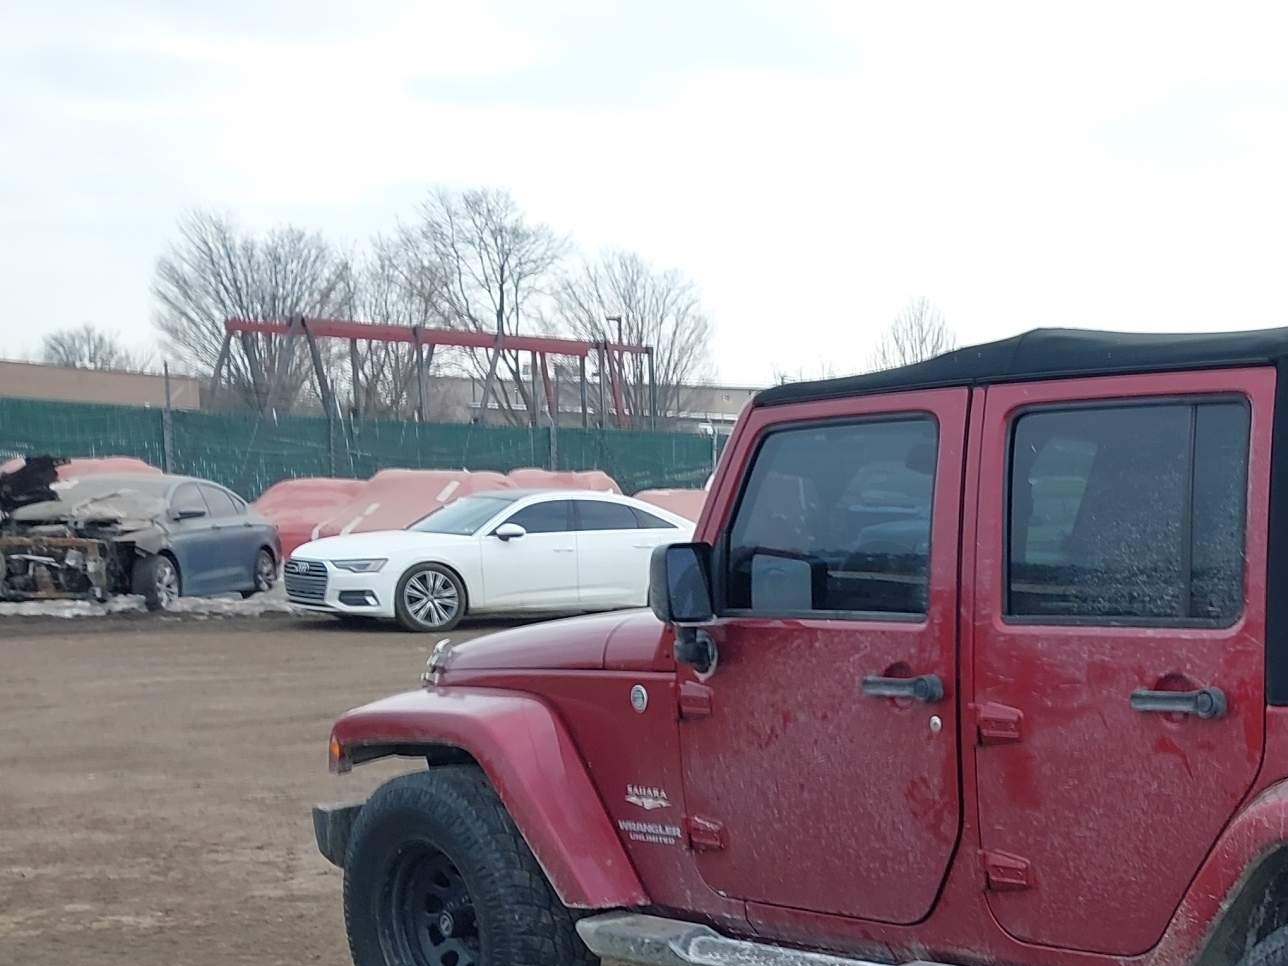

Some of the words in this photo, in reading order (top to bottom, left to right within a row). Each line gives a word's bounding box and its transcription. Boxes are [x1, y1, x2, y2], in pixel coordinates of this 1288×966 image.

[626, 784, 668, 799] SAHARA
[617, 820, 682, 839] WRANGLER
[629, 833, 675, 845] UNLIMITED
